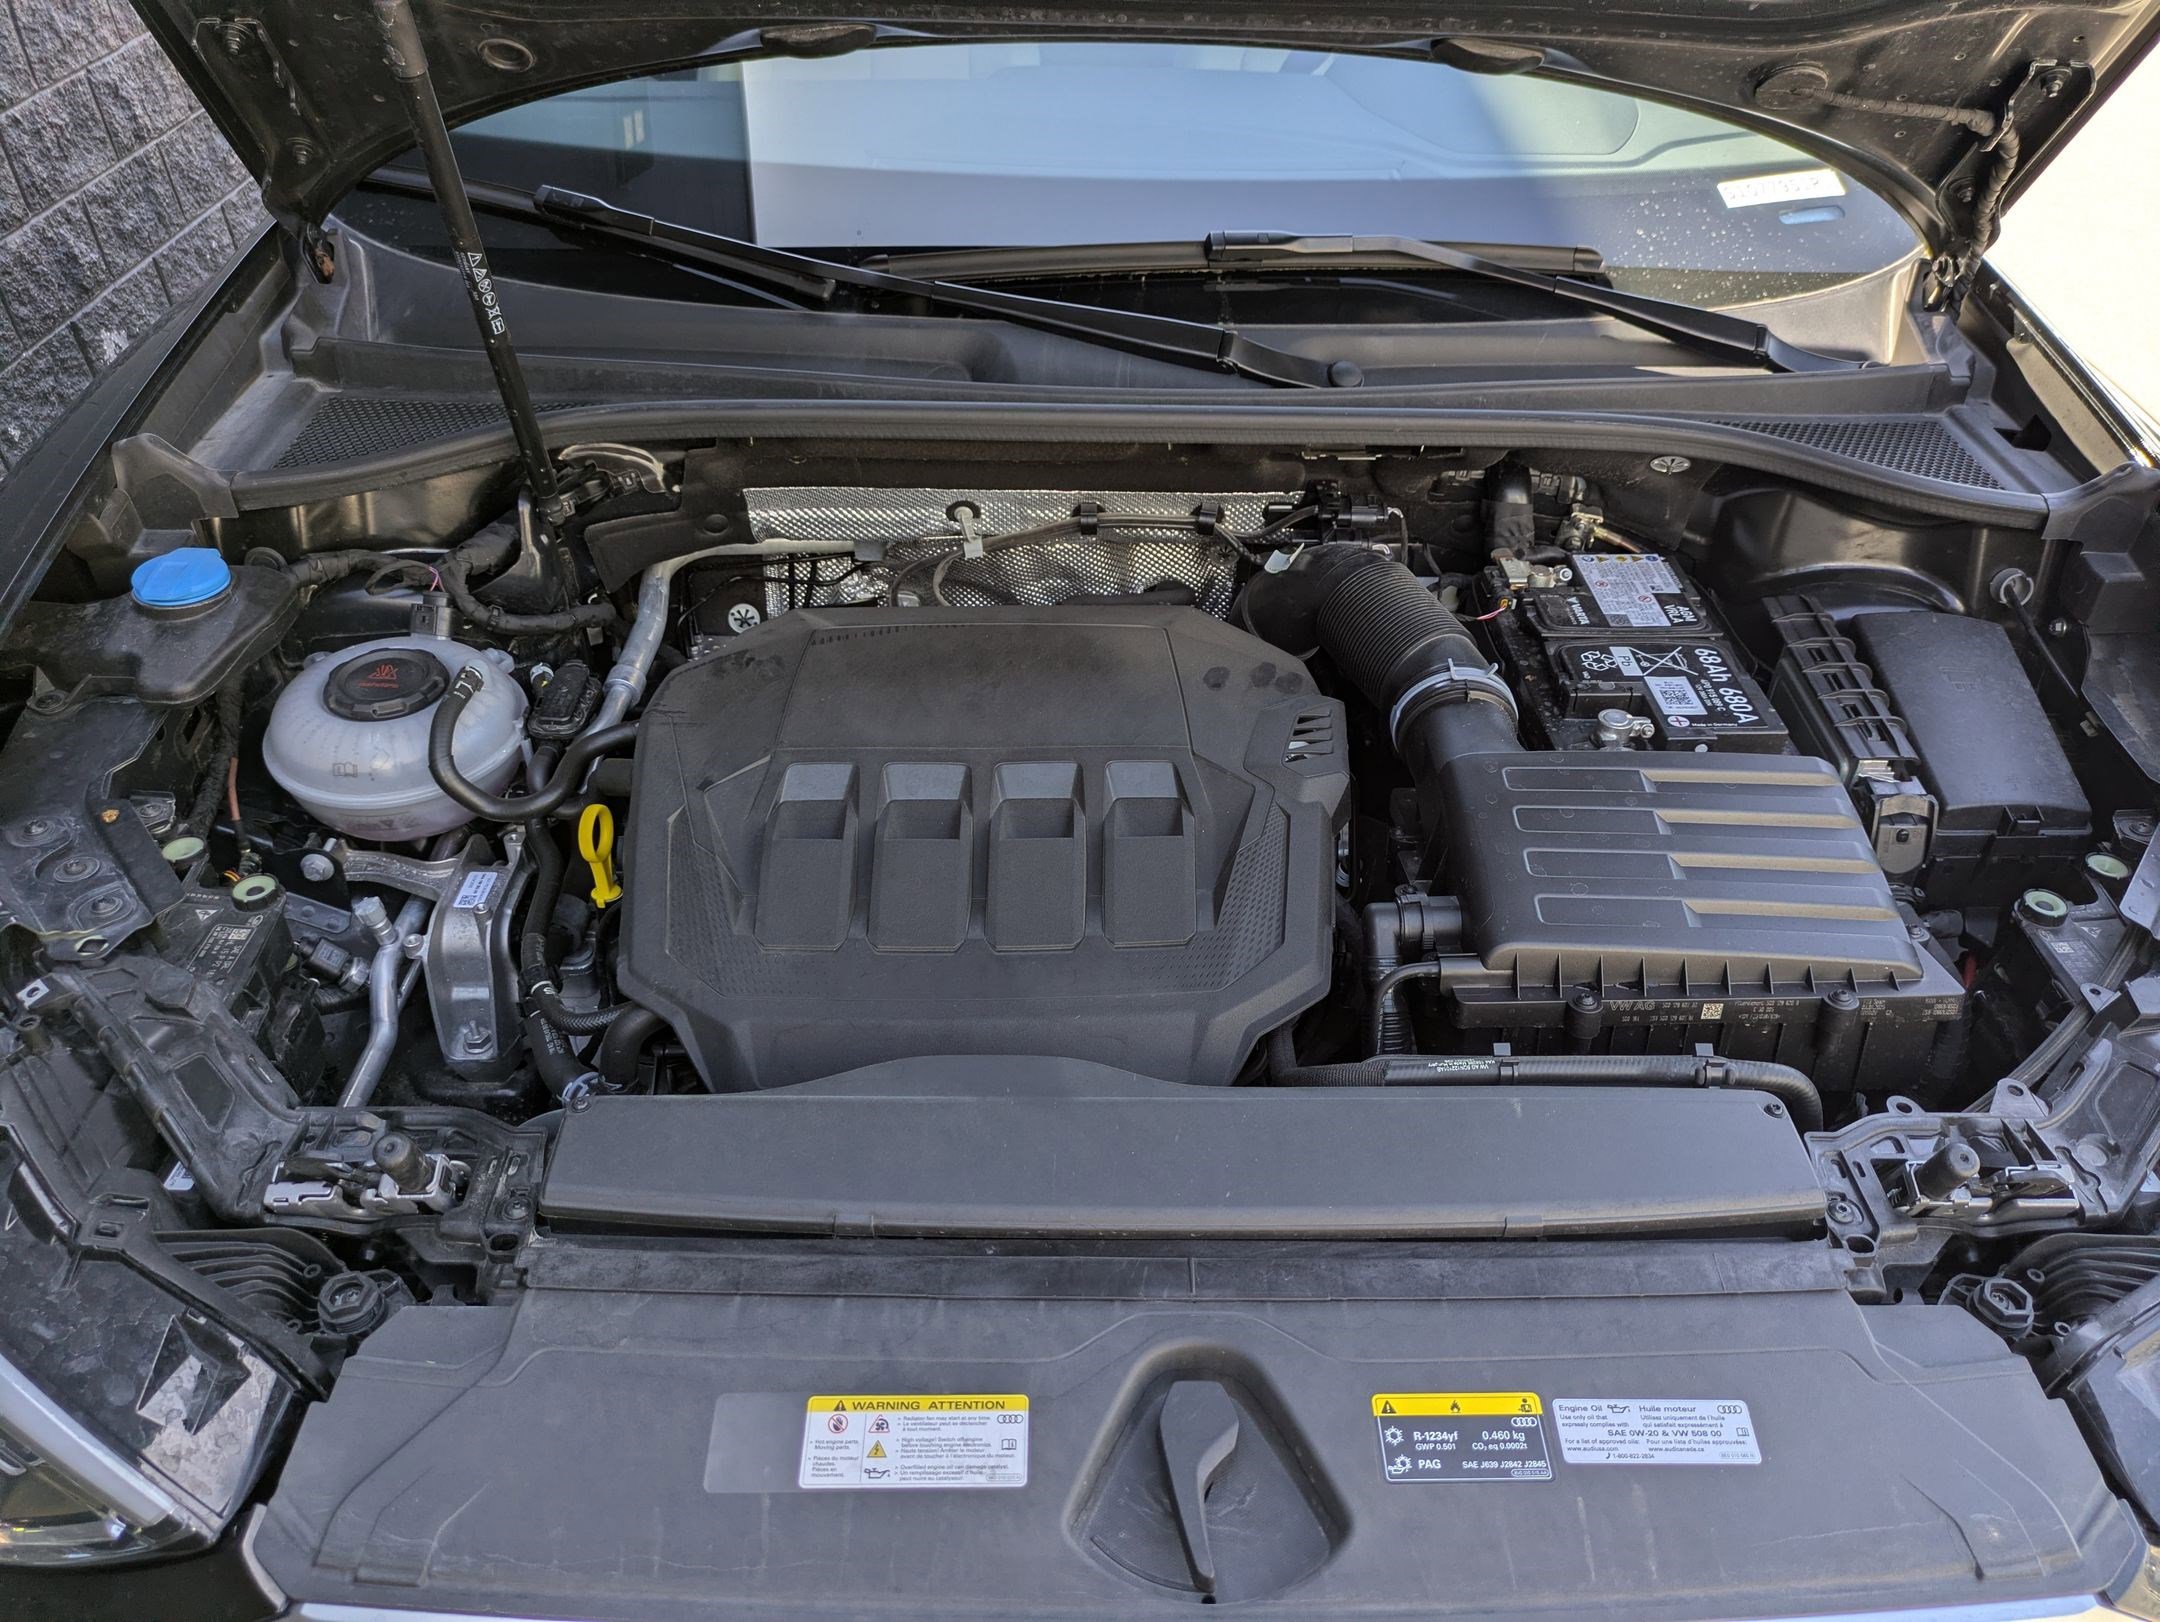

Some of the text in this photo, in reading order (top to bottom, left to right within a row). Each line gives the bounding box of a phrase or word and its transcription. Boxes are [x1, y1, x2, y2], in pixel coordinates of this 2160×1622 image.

[1572, 604, 1590, 624] VARTA
[1664, 604, 1684, 624] VRLA
[1676, 606, 1698, 622] AGM
[1618, 655, 1632, 667] Pb
[1694, 648, 1759, 724] 68Ah 680A
[1610, 1000, 1634, 1011] VW
[1633, 1000, 1656, 1010] AG
[852, 1400, 1006, 1410] WARNING ATTENTION
[1413, 1431, 1458, 1442] R-1234yf
[1482, 1430, 1525, 1441] 0.460 kg
[1418, 1459, 1441, 1469] PAG
[1524, 1460, 1546, 1468] J2845
